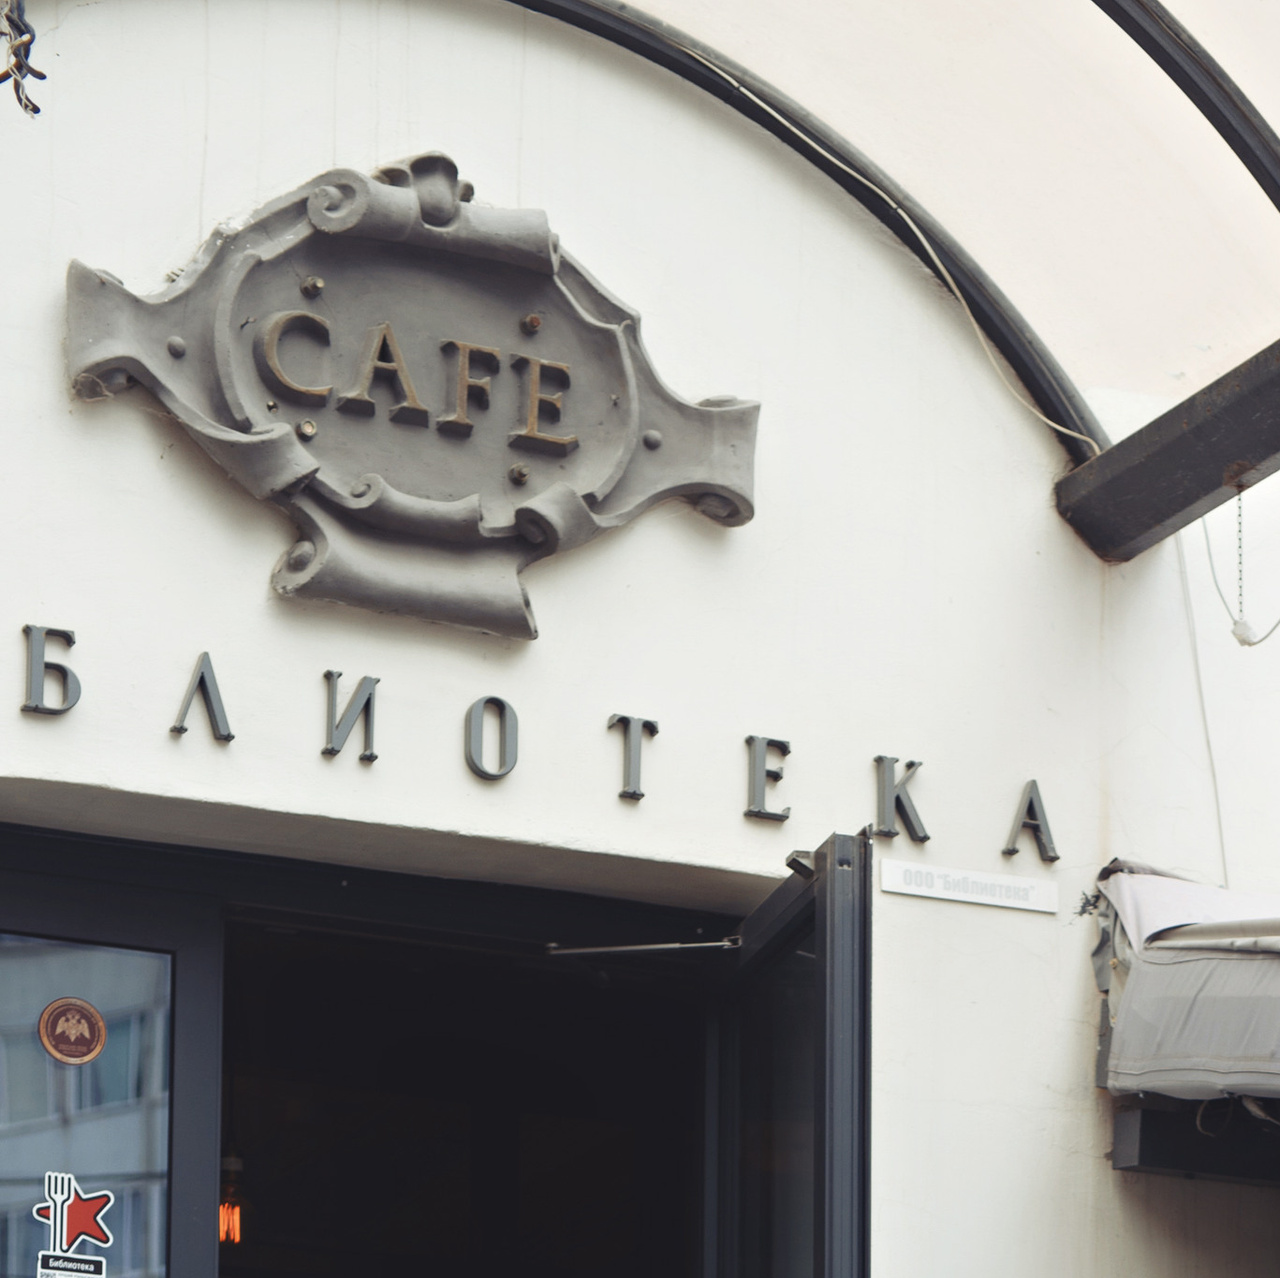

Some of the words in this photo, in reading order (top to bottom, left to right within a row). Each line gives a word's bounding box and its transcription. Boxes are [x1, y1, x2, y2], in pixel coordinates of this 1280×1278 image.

[258, 310, 580, 456] CAFE
[903, 869, 934, 888] ООО
[938, 875, 1035, 901] "Библиотека"
[49, 1258, 95, 1272] Библиотека
